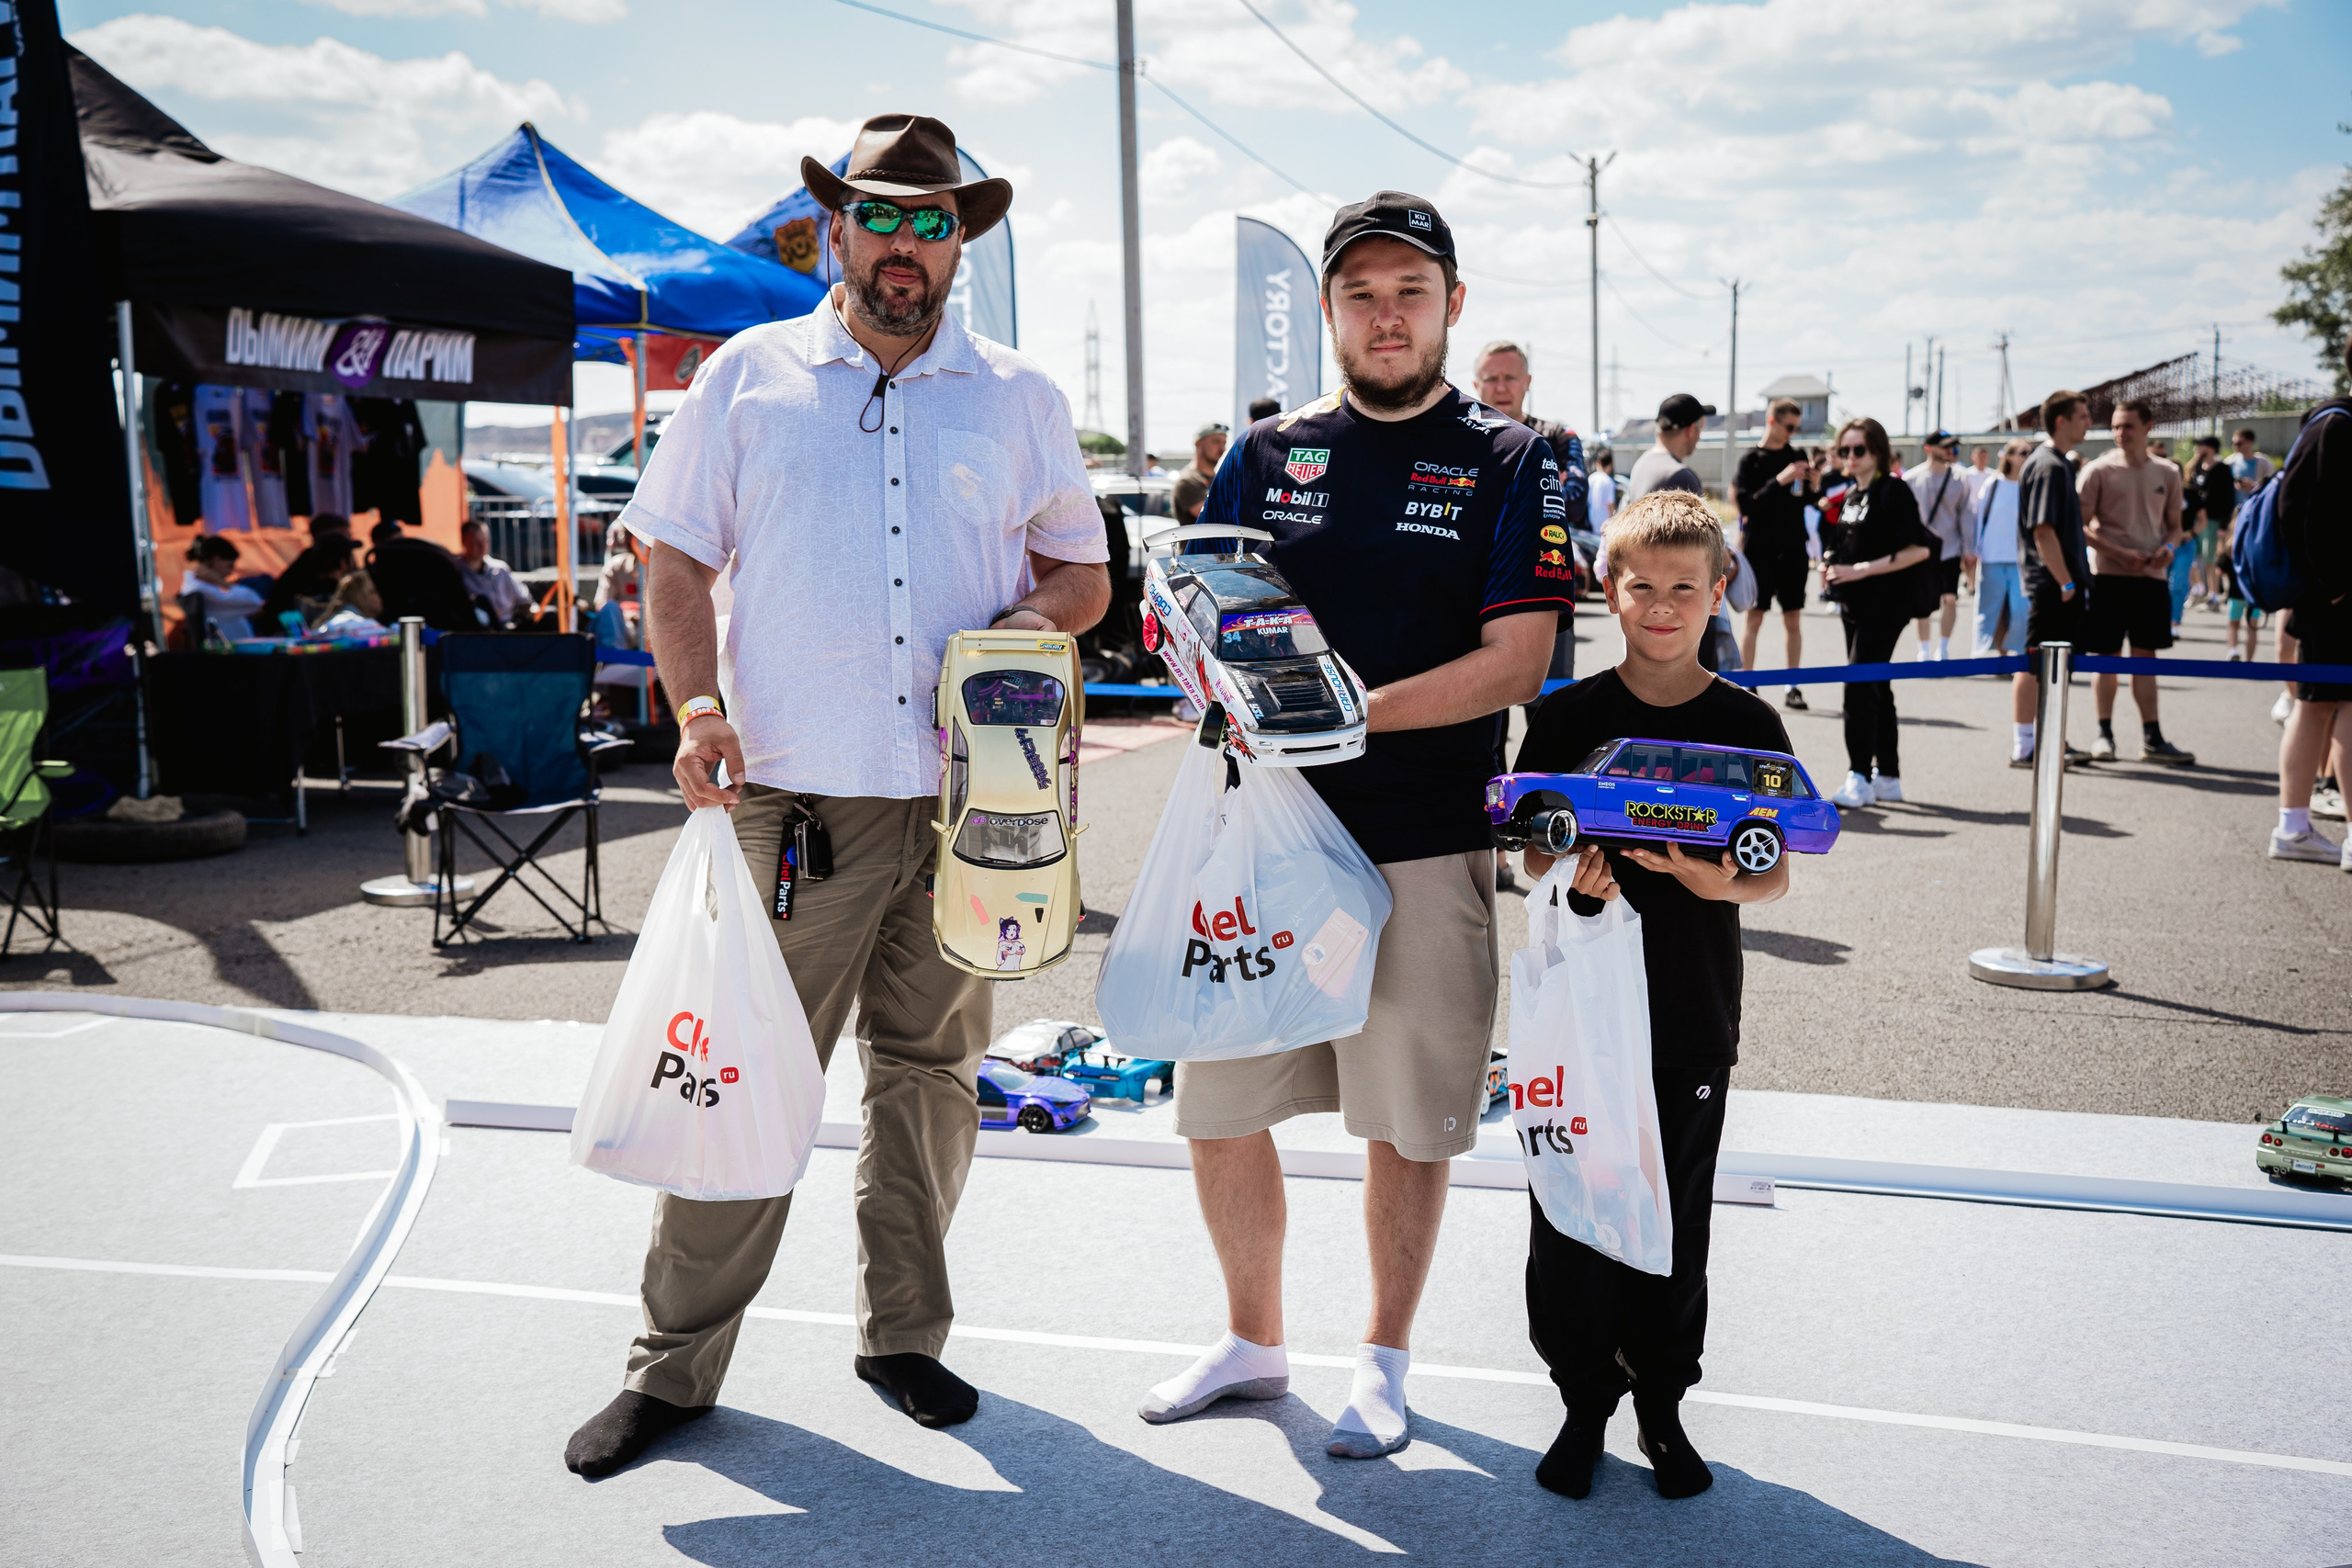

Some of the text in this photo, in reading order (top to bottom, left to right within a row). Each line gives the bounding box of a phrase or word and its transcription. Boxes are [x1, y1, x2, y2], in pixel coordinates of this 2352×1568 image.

[1411, 220, 1430, 228] MAR
[1294, 451, 1327, 463] TAG
[1287, 463, 1325, 481] HEUER
[1414, 461, 1479, 477] ORACLE
[1410, 473, 1447, 485] Red Bull
[1266, 488, 1312, 506] Mobil
[1408, 484, 1474, 497] RACING
[1262, 510, 1323, 525] ORACLE
[1405, 502, 1463, 521] BYBIT
[1395, 522, 1461, 540] HONDA
[1535, 565, 1573, 581] Red Bull
[1223, 631, 1241, 644] 34
[1256, 626, 1289, 636] KUMAR
[1162, 649, 1206, 711] www.ps-taka.com
[1763, 774, 1781, 788] 10
[1748, 807, 1780, 818] AEM
[1632, 817, 1707, 831] ENERGY DRINK
[1301, 882, 1329, 910] AIRLINE
[1193, 896, 1256, 942] Cel
[1276, 935, 1290, 945] ru
[723, 1071, 735, 1079] ru
[1574, 1121, 1586, 1130] ru
